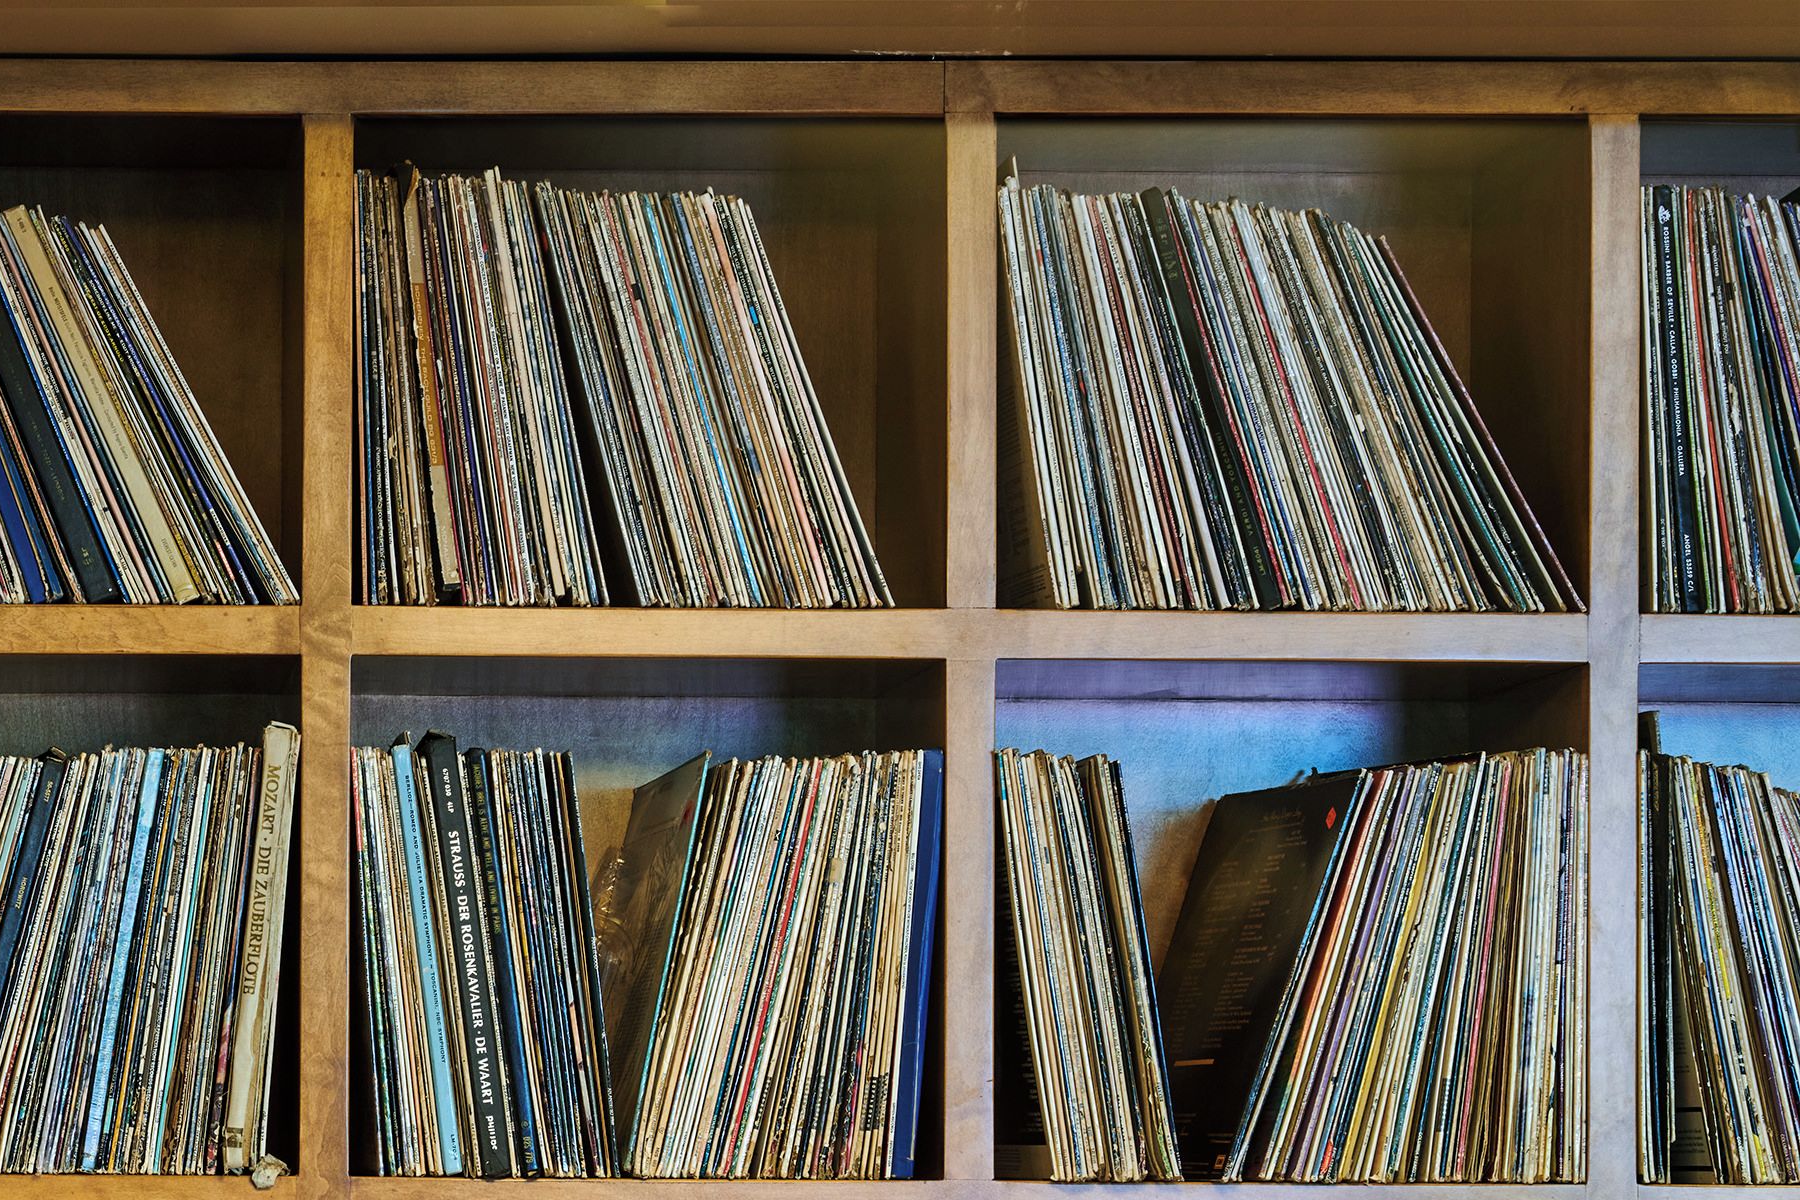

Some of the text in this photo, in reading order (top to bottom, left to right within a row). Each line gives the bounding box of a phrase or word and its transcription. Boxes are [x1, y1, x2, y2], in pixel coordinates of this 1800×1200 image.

[1666, 286, 1672, 295] OF
[1670, 358, 1678, 378] GOBBI
[1672, 387, 1682, 436] PHILHARMONIA
[1676, 445, 1684, 476] GALLIERA
[1683, 534, 1691, 556] ANGEL
[441, 768, 449, 782] 6707
[471, 764, 481, 788] JACQUES
[260, 763, 281, 835] MOZART
[443, 784, 451, 796] 030
[475, 791, 484, 807] BREL
[446, 801, 454, 812] 4LP
[478, 817, 488, 833] ALIVE
[481, 837, 490, 849] AND
[256, 845, 272, 875] DIE
[448, 830, 465, 887] STRAUSS
[483, 851, 492, 866] WELL
[485, 870, 494, 882] AND
[13, 876, 28, 909] HOROWITZ
[487, 885, 497, 903] LIVING
[456, 895, 470, 921] DER
[491, 915, 501, 934] PARIS
[460, 924, 484, 1028] ROSENKAVALIER
[474, 1036, 487, 1054] DE
[477, 1057, 494, 1104] WAART
